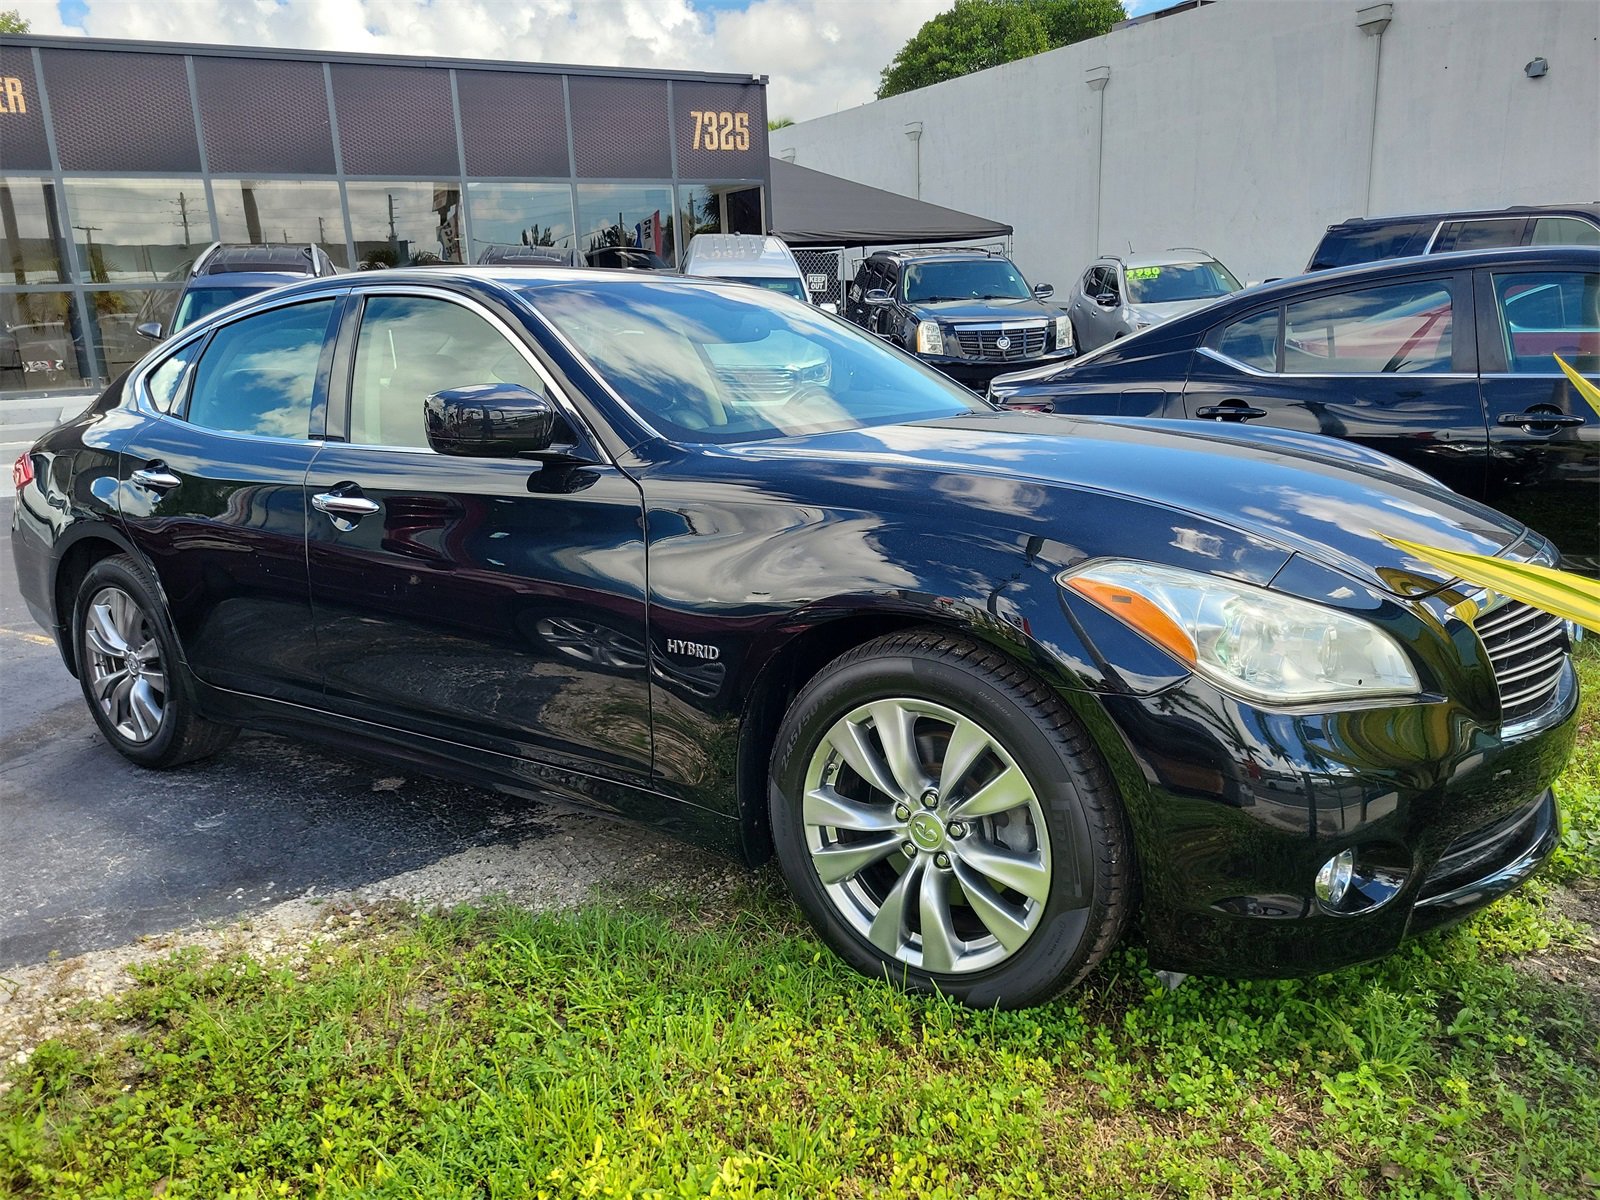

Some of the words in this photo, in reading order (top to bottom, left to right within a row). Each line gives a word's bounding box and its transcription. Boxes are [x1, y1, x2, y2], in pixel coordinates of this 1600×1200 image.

[690, 111, 750, 151] 7325
[810, 282, 824, 290] OUT
[666, 638, 720, 660] HYBRID
